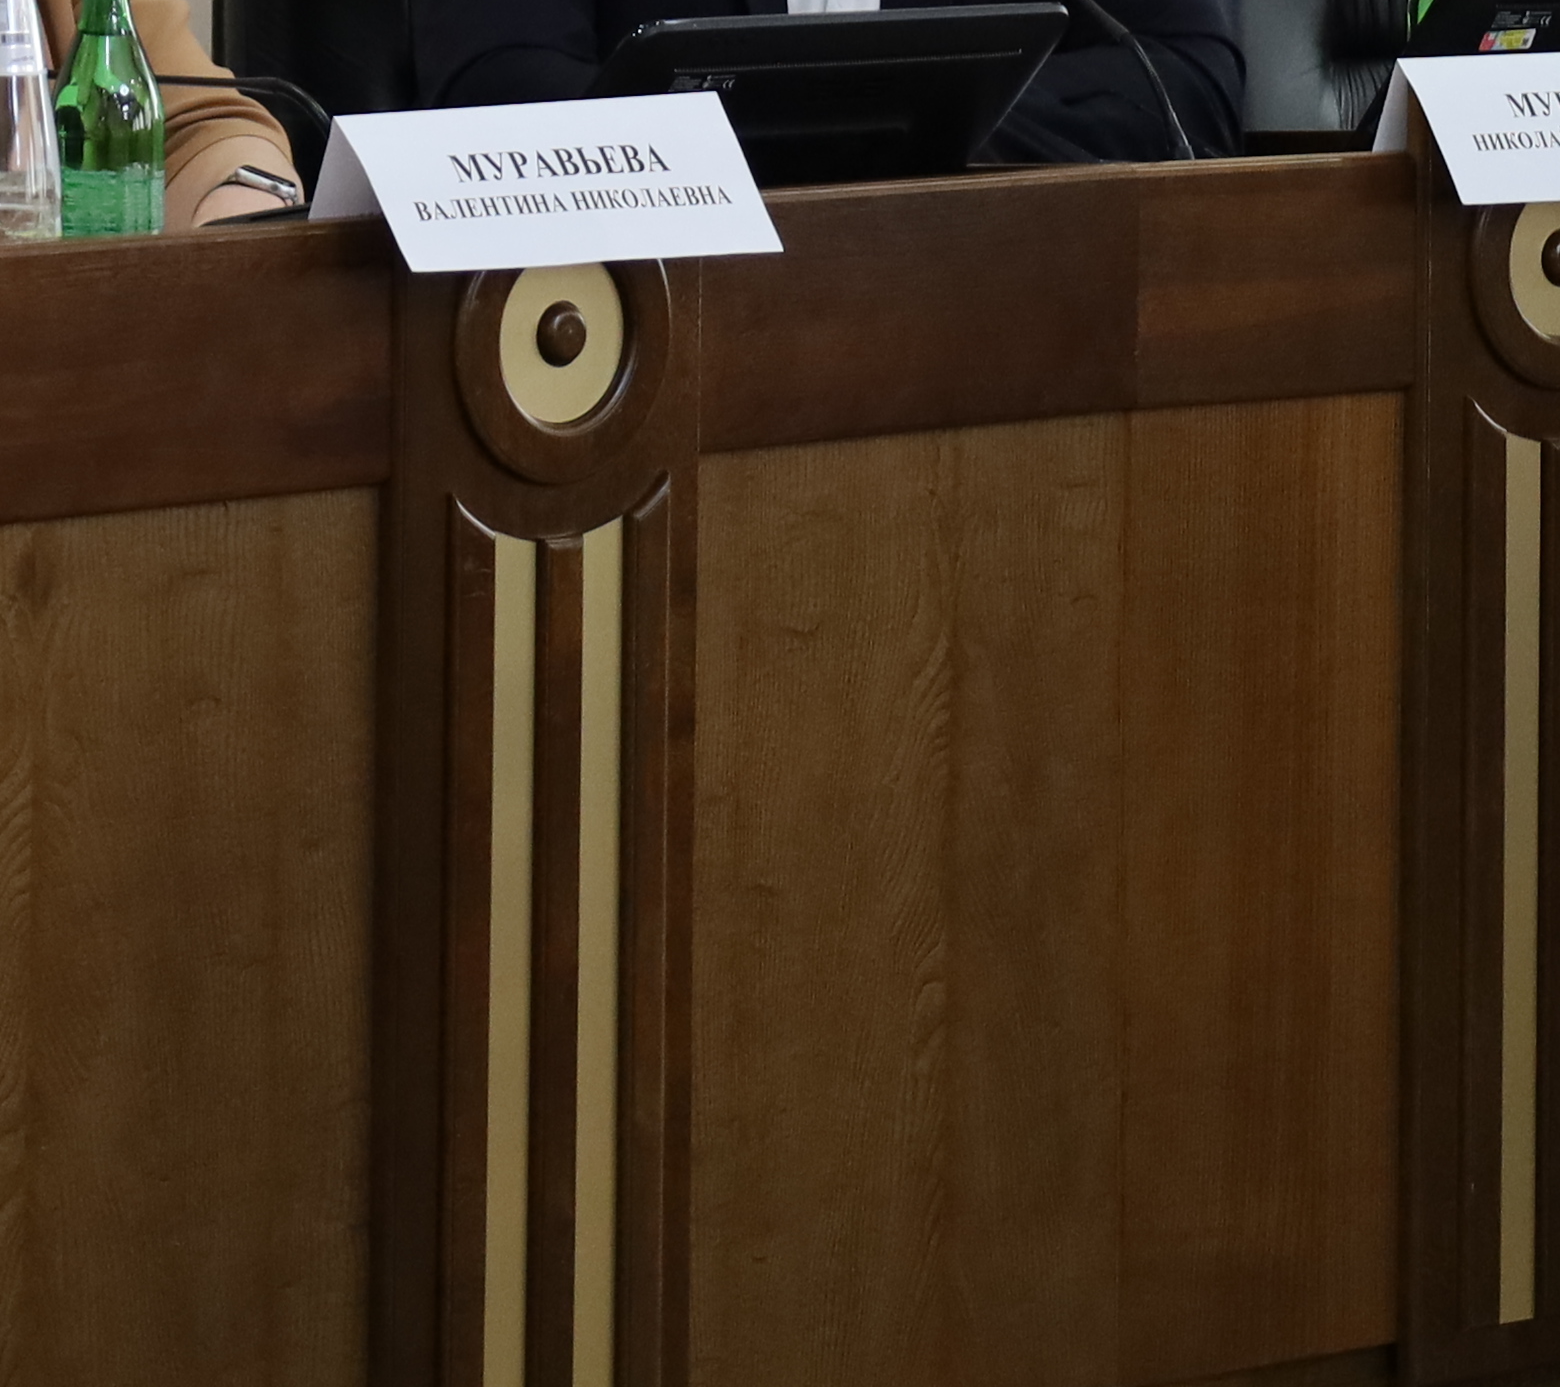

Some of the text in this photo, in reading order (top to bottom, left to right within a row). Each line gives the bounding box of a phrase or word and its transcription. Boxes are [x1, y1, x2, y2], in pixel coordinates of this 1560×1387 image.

[446, 143, 672, 184] МУРАВЬЕВА
[412, 185, 733, 223] ВАЛЕНТИНА НИКОЛАЕВНА
